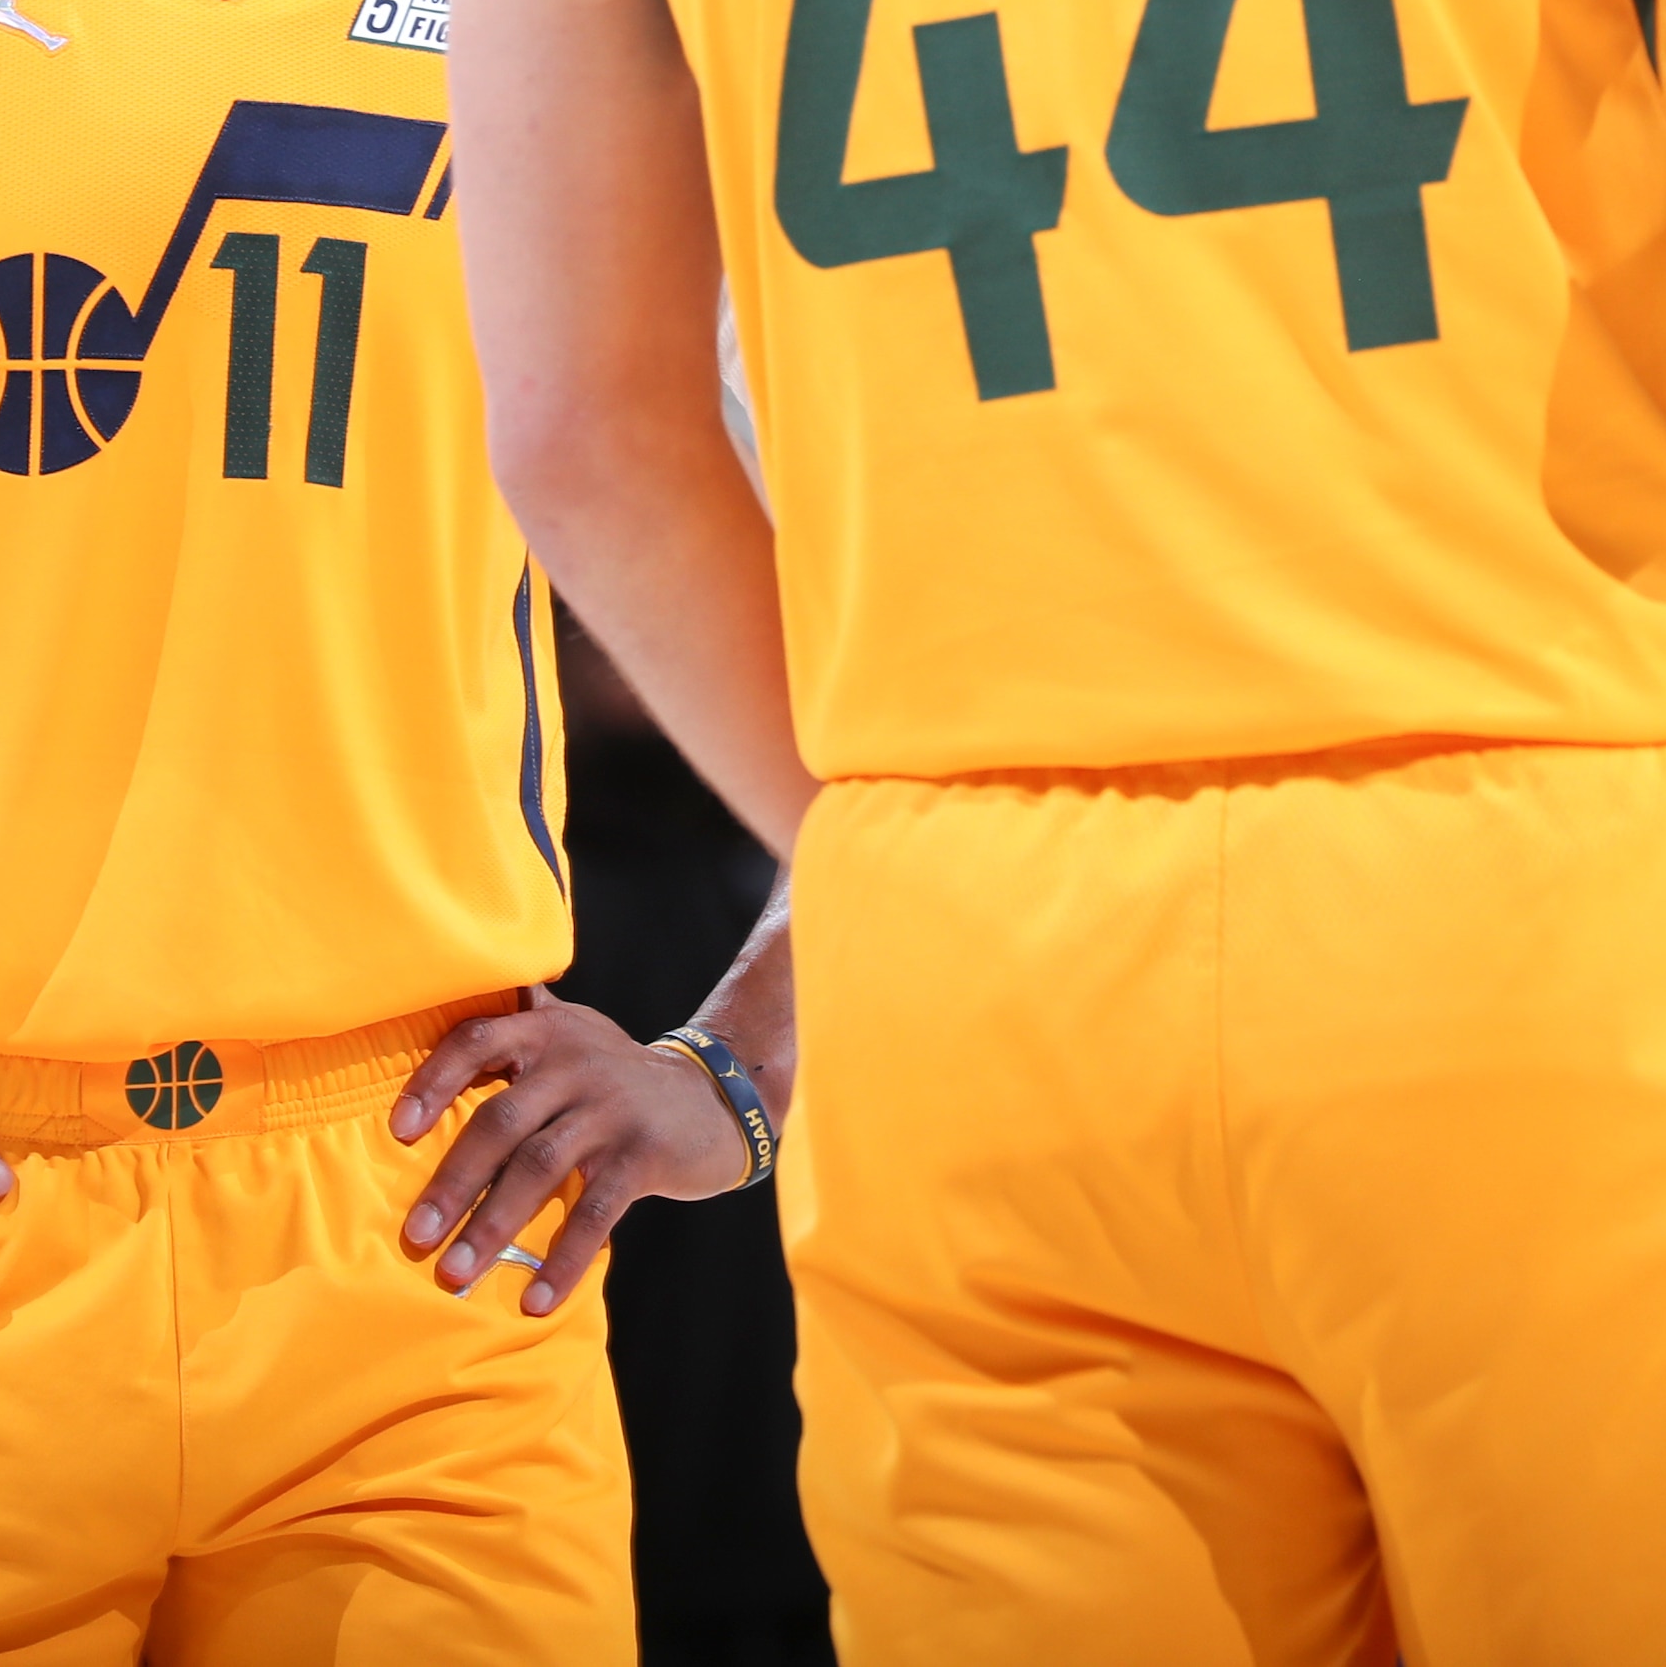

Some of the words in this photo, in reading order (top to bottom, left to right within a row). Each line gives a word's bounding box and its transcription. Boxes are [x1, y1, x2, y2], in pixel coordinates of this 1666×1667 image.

[408, 16, 450, 43] FIG
[210, 231, 368, 488] 11
[744, 1108, 771, 1170] NOAH
